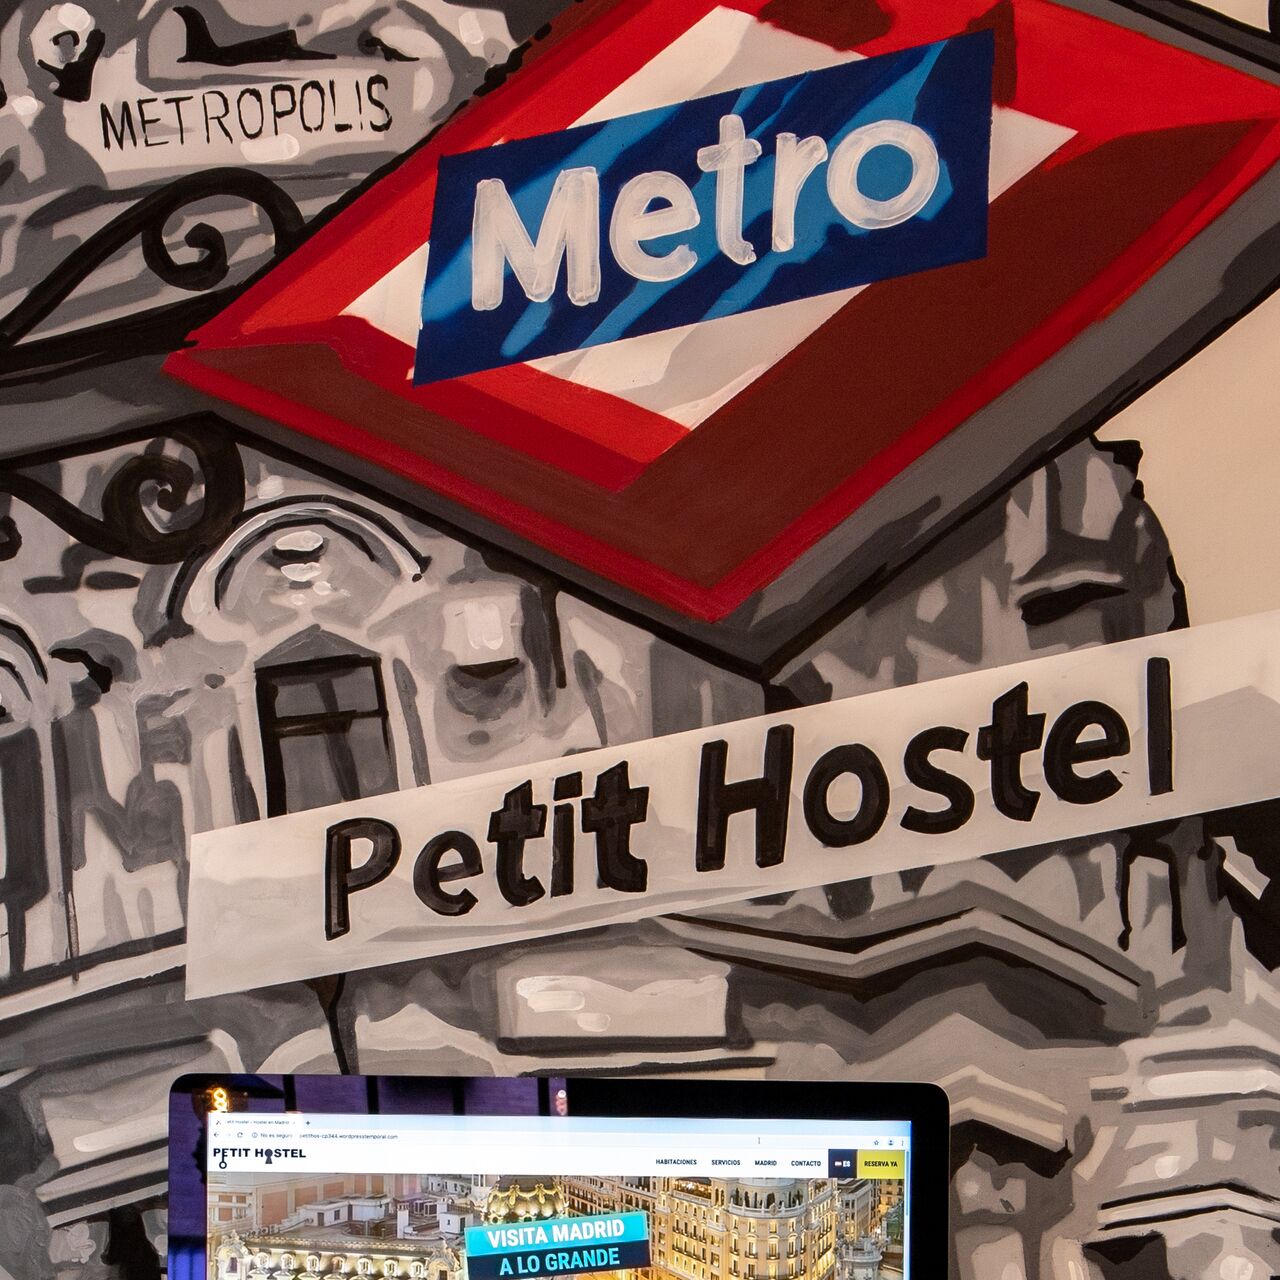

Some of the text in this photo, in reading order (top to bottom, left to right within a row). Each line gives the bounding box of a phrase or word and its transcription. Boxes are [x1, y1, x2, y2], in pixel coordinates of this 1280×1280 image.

[99, 74, 393, 151] METROPOLIS
[471, 114, 941, 311] Metro
[324, 656, 1175, 942] Petit Hostel
[213, 1147, 251, 1163] PETIT
[655, 1158, 697, 1166] HABITACIONES
[864, 1160, 898, 1168] RESERVA YA
[487, 1218, 625, 1249] VISITA MADRID
[499, 1247, 620, 1276] A LO GRANDE
